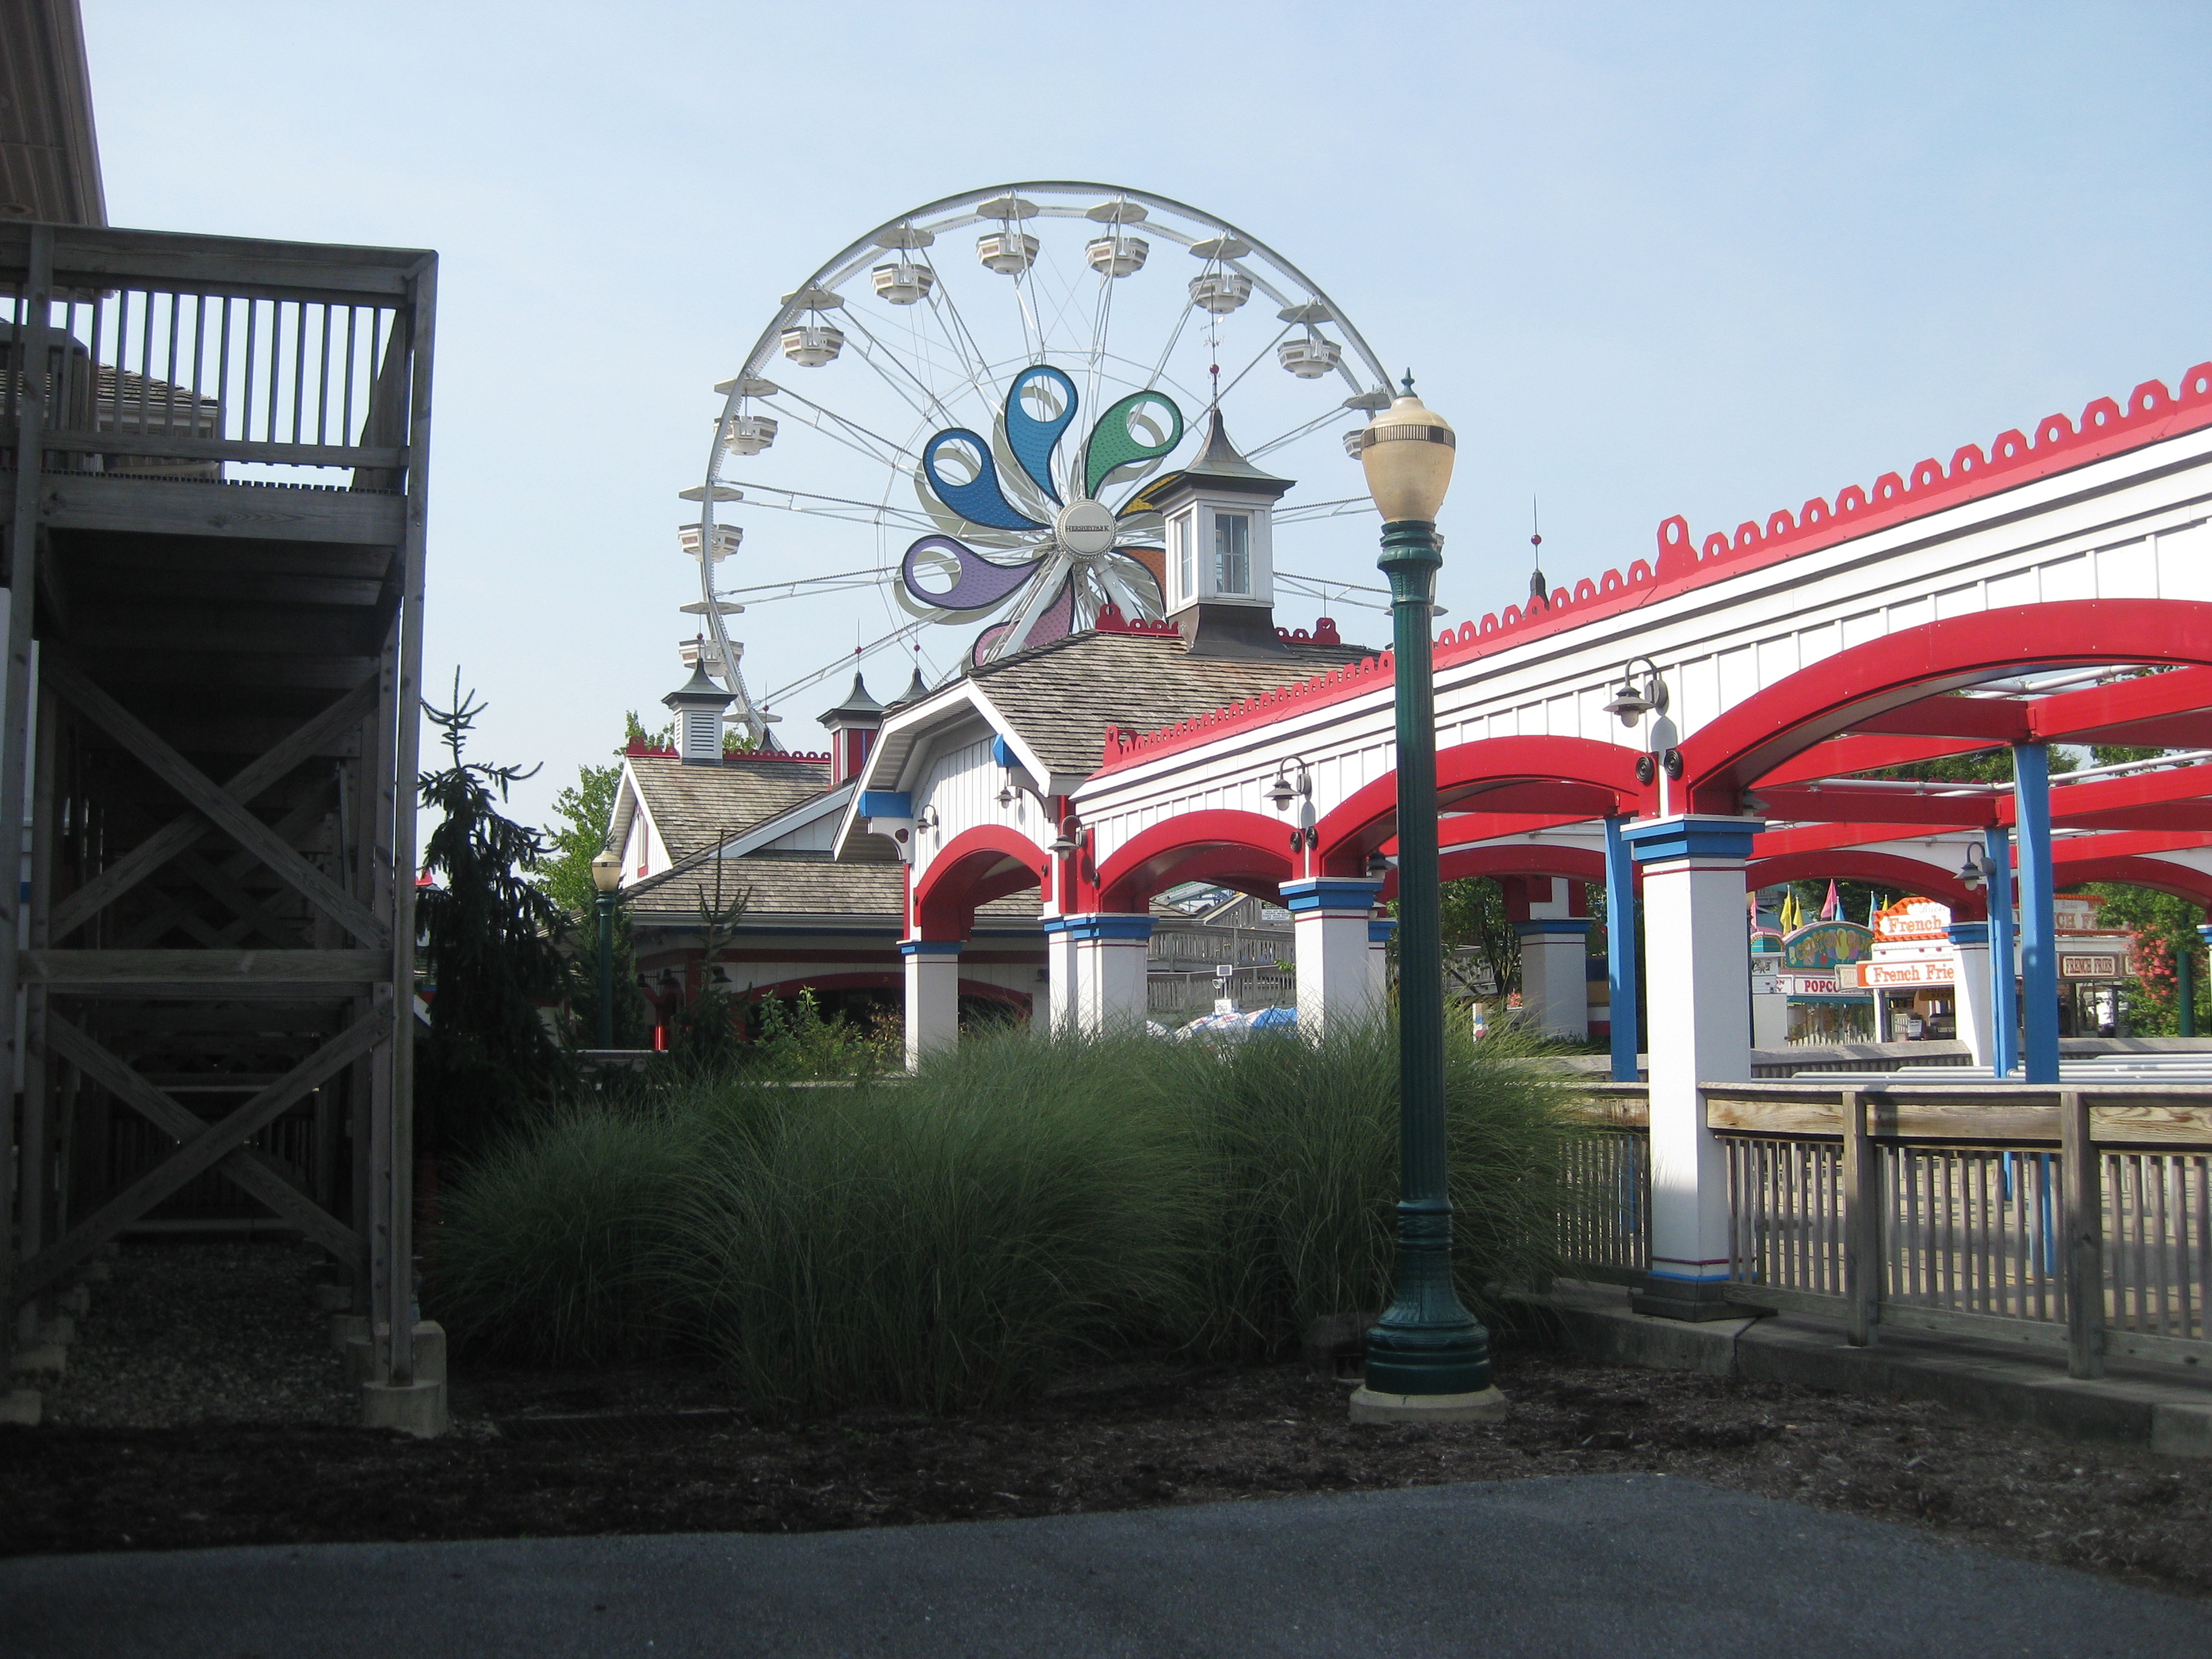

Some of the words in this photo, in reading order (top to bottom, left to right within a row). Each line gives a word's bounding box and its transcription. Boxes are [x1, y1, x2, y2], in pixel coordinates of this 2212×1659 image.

[1888, 915, 1942, 933] French
[1873, 965, 1921, 983] French
[1925, 964, 1954, 980] Frie
[2066, 958, 2091, 974] FRENCH
[2093, 958, 2112, 974] FRIES
[1804, 979, 1840, 993] POPC
